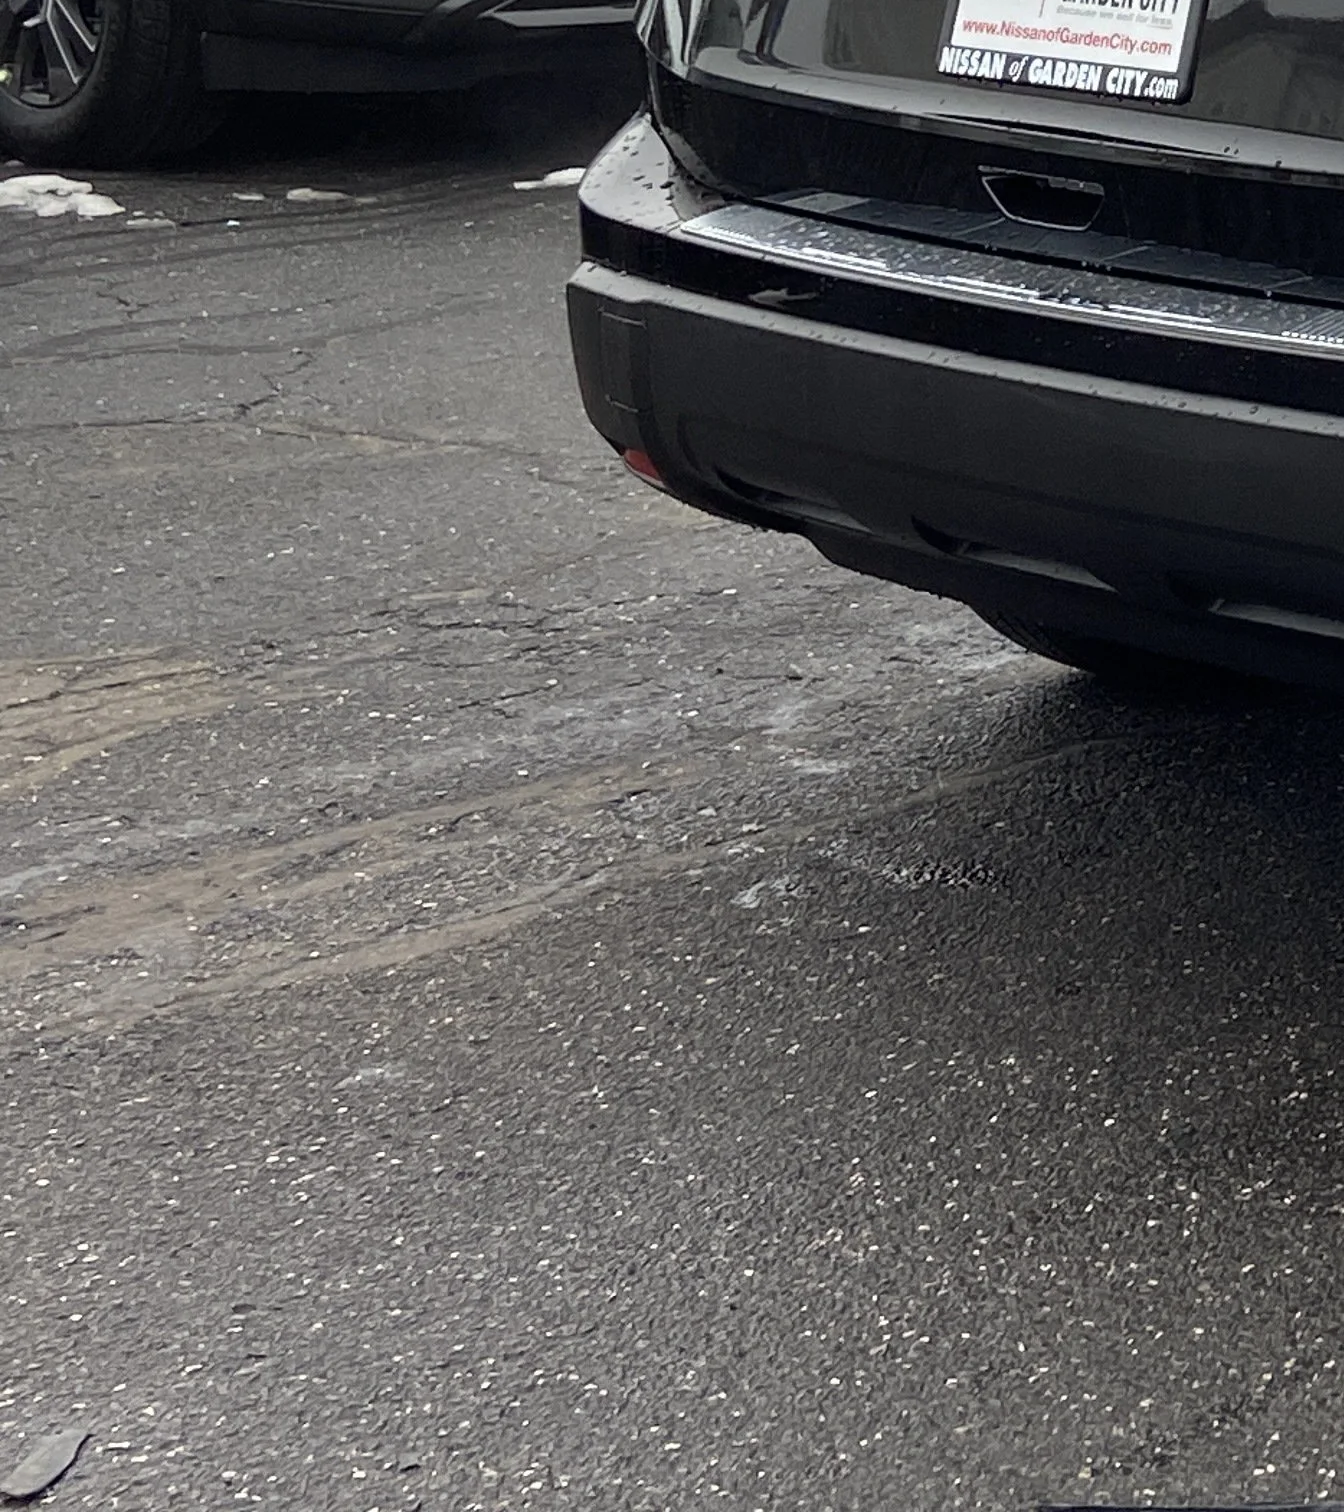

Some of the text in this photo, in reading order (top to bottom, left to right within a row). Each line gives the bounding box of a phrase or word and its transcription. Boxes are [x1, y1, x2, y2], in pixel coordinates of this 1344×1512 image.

[962, 19, 1173, 56] www.NissanofGardenCity.com
[938, 45, 1180, 100] NISSAN of GARDEN CITY.com
